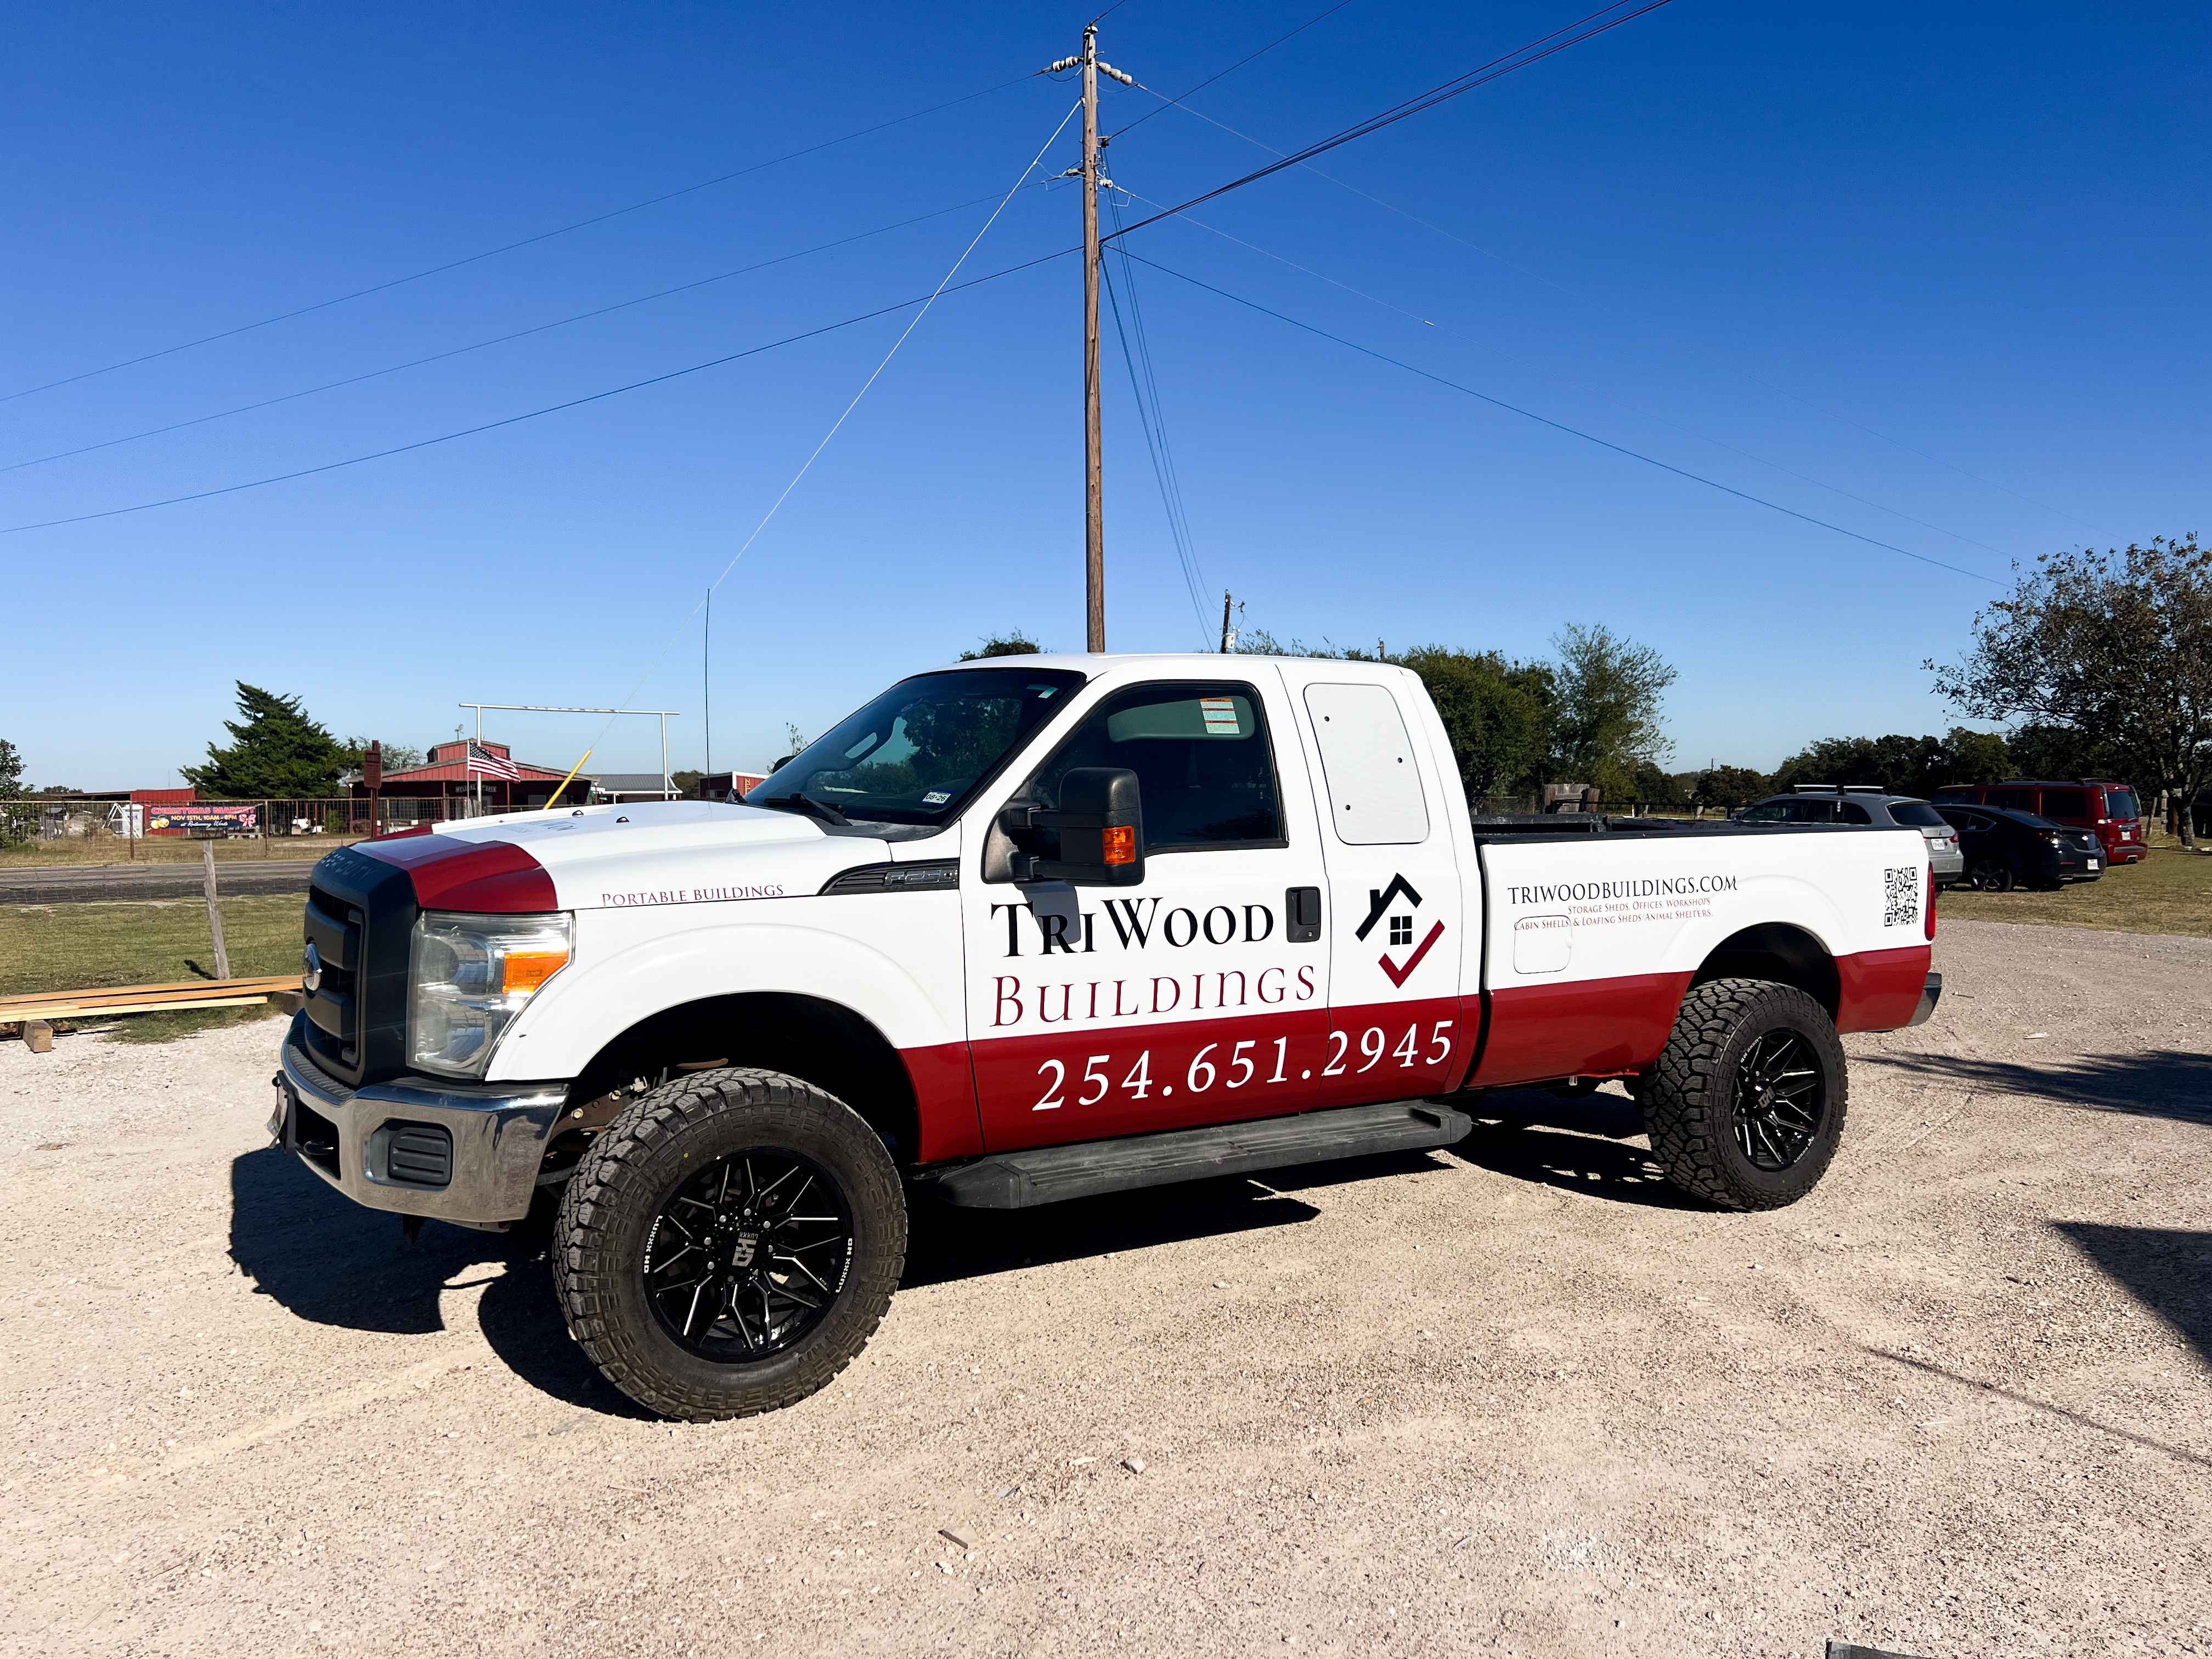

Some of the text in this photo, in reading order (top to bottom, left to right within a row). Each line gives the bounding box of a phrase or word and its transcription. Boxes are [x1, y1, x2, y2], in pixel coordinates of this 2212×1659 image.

[151, 806, 211, 815] CHRISTMAS
[336, 860, 378, 881] DUTY
[601, 884, 784, 907] PORTABLE BUILDINGS
[1508, 875, 1739, 905] TRIWOODBUILDINGS.COM
[1568, 898, 1711, 915] STORAGE SHEDS, OFFICES, WORKSHOPS
[1514, 921, 1539, 930] CABIN
[1573, 917, 1580, 927] &
[1582, 916, 1616, 926] LOAFING
[1618, 912, 1674, 923] SHEDS/ANIMAL
[1675, 909, 1714, 919] SHELTERS.
[989, 964, 1315, 1028] BUILDINGS
[1032, 1020, 1454, 1111] 254.651.2945
[644, 1215, 663, 1273] LUXXX HD
[739, 1231, 759, 1240] LUXXX
[836, 1238, 853, 1293] LUXXX HD
